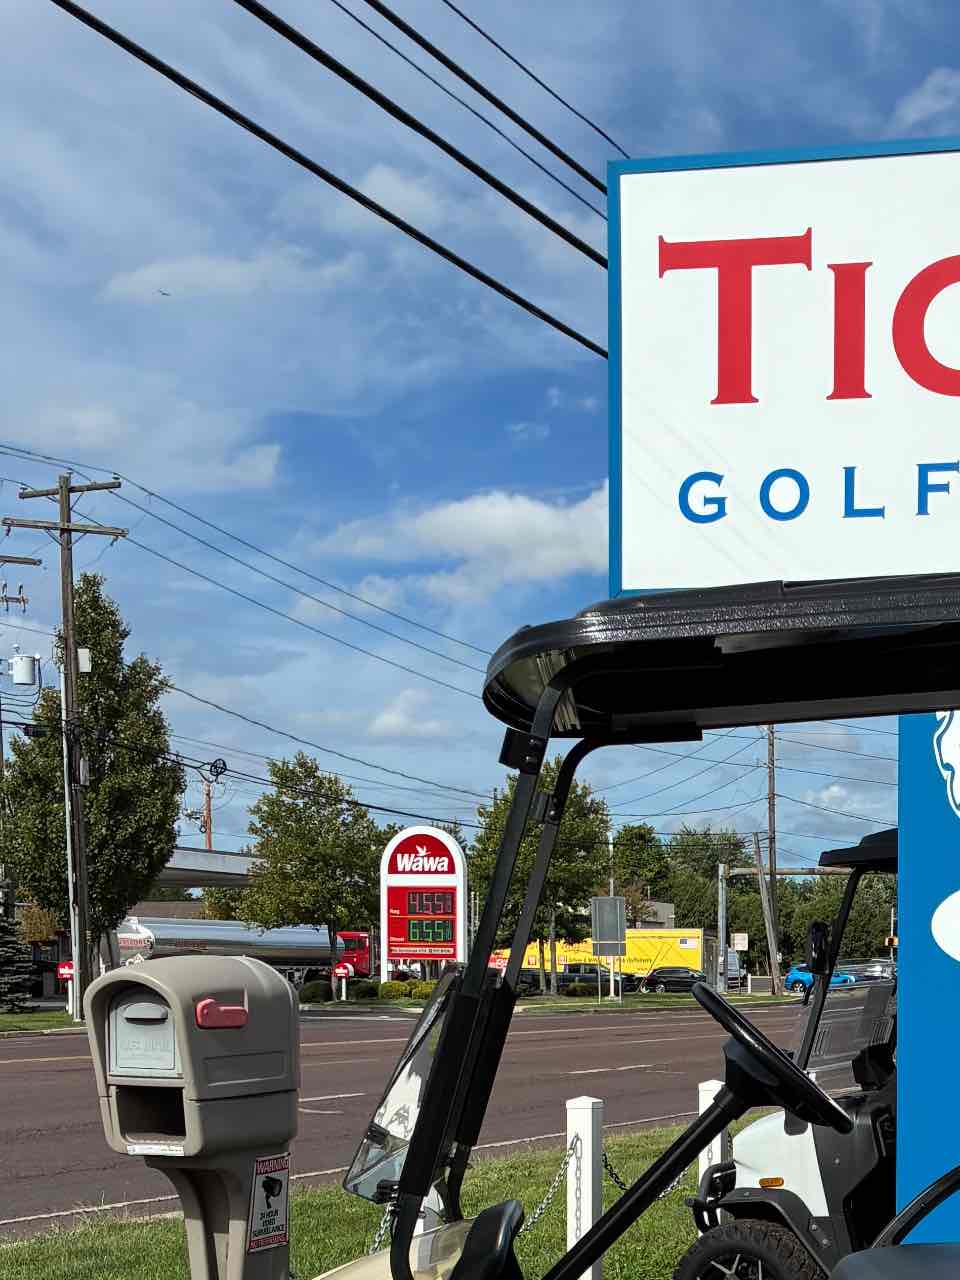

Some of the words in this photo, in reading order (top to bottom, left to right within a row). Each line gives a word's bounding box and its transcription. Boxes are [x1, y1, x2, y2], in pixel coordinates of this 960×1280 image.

[678, 462, 960, 525] GOLF
[396, 853, 449, 872] Wawa
[256, 1158, 288, 1174] WARNING
